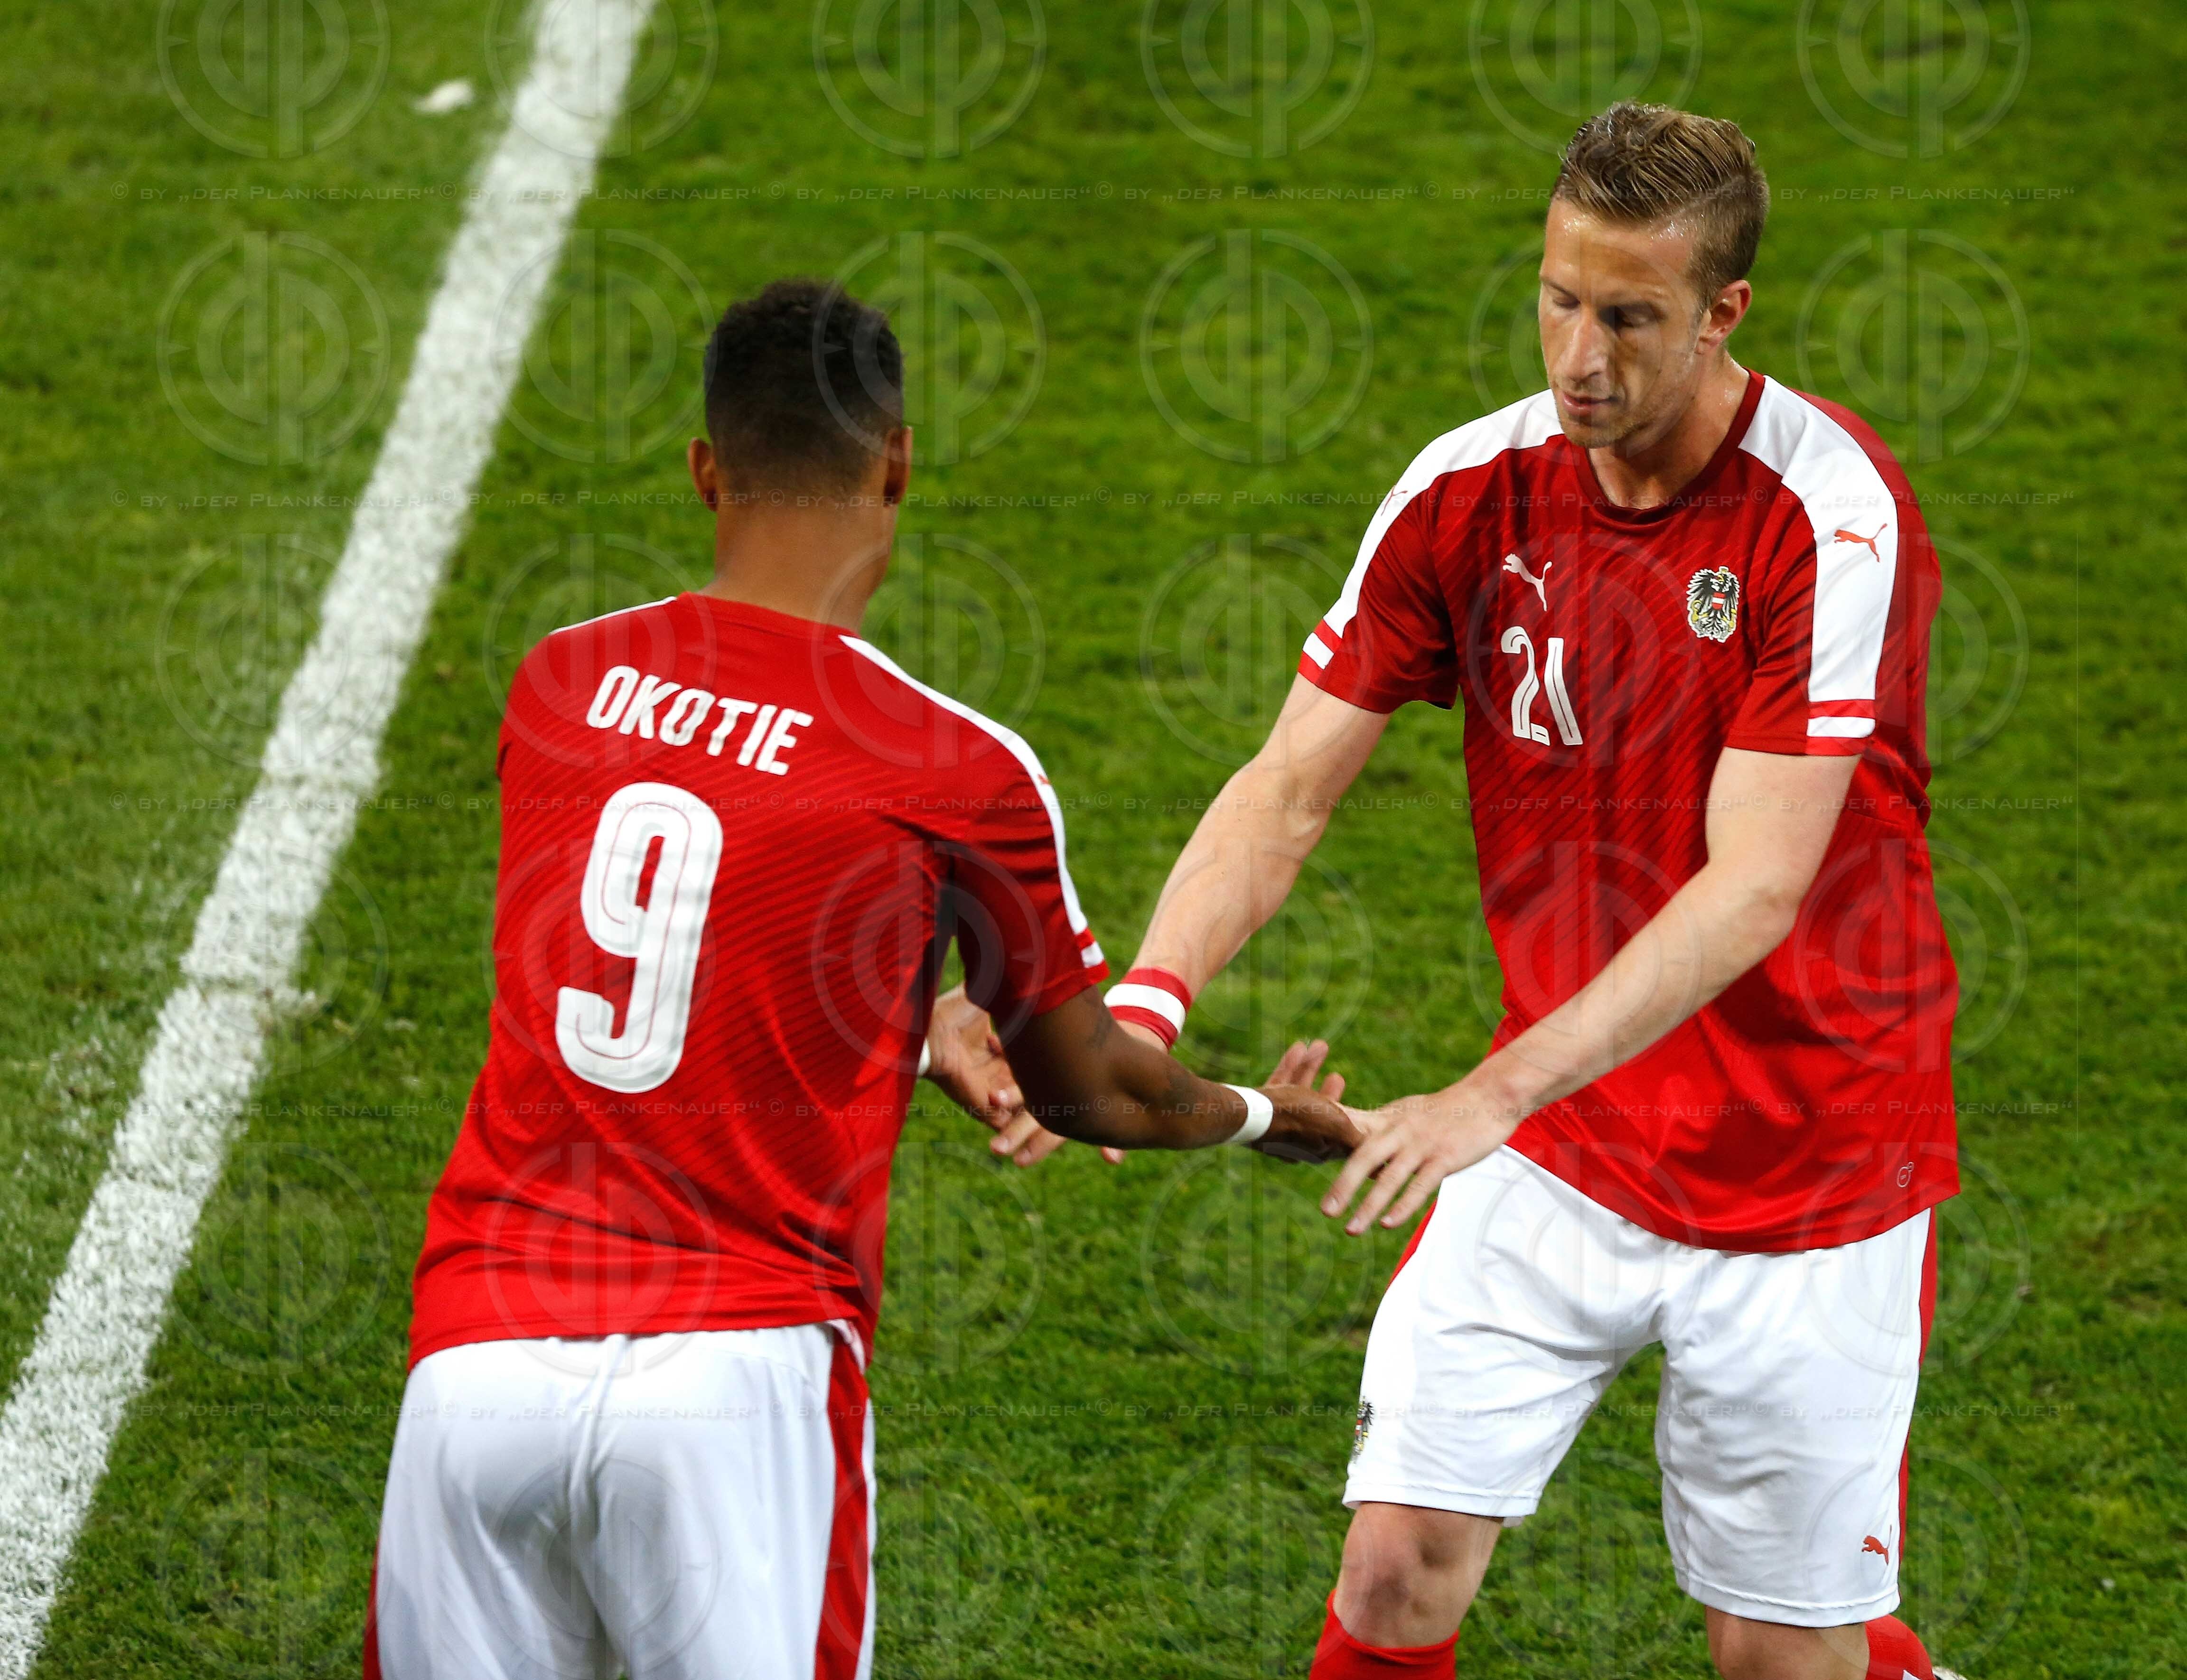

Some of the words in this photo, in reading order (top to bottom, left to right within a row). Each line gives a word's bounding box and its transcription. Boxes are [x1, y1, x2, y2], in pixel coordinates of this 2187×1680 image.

[587, 665, 813, 776] OKOTIE
[1501, 626, 1583, 746] 21
[555, 782, 723, 1093] 9
